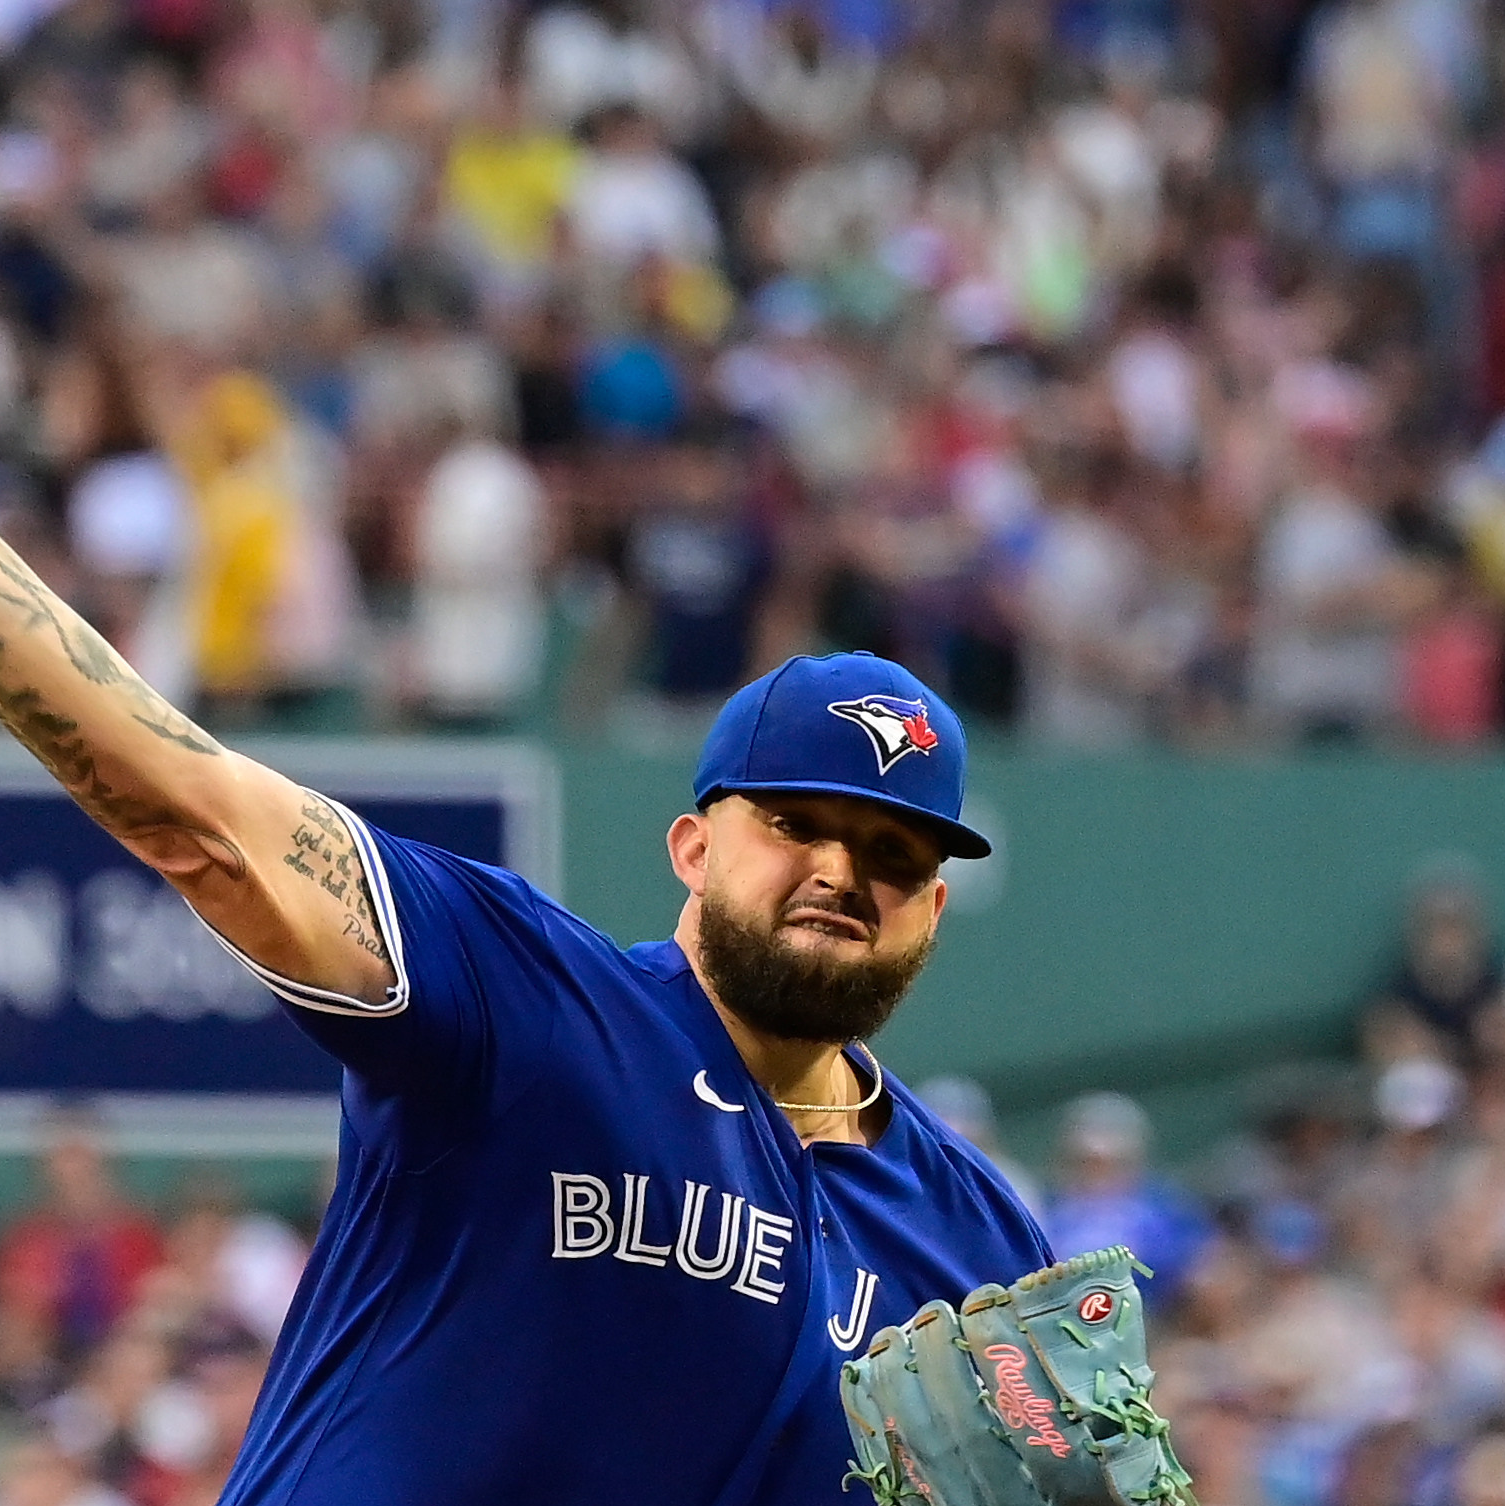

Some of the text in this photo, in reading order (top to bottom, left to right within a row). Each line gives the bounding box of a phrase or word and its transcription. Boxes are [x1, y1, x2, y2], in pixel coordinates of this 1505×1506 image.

[551, 1171, 880, 1352] BLUE J
[984, 1343, 1072, 1459] Rawlings
